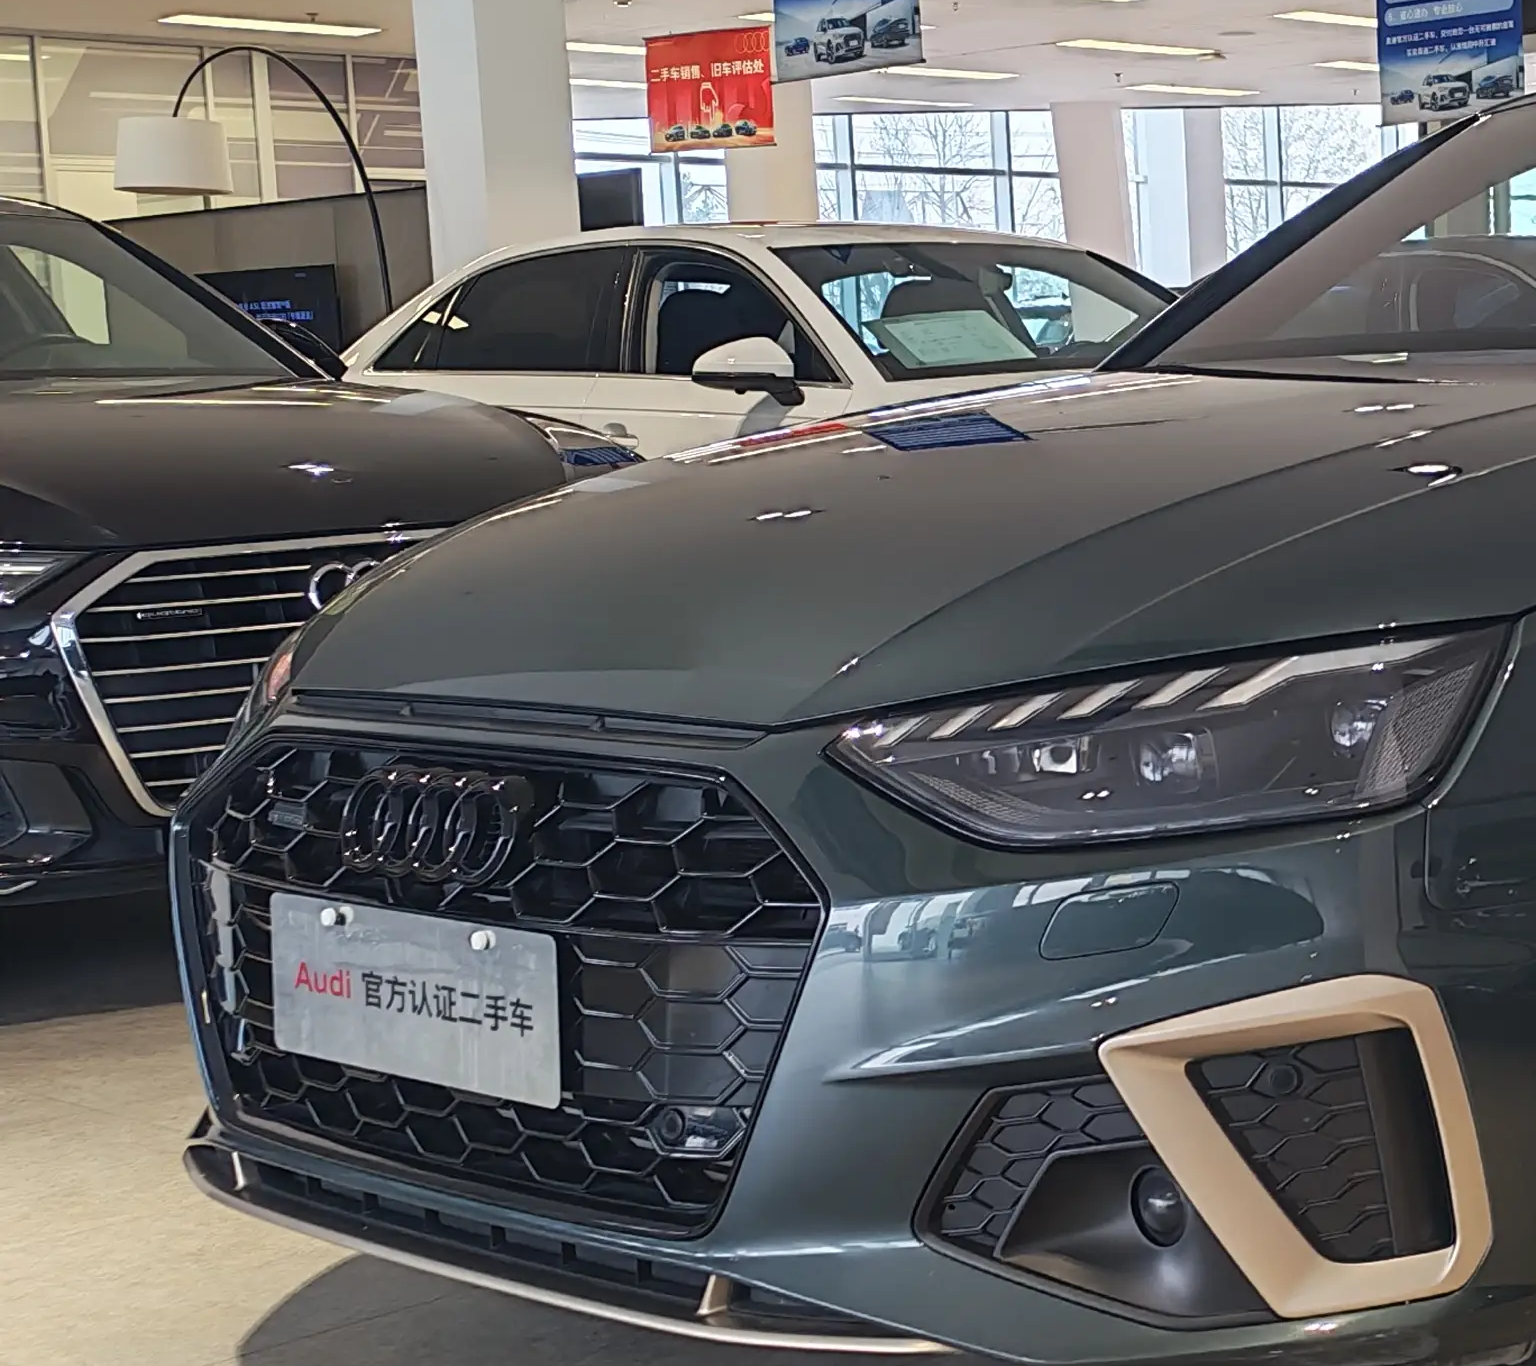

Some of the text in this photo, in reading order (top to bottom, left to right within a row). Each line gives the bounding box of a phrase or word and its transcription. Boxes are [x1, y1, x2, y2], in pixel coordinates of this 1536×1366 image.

[295, 962, 534, 1037] Audi 官方认证二手车
